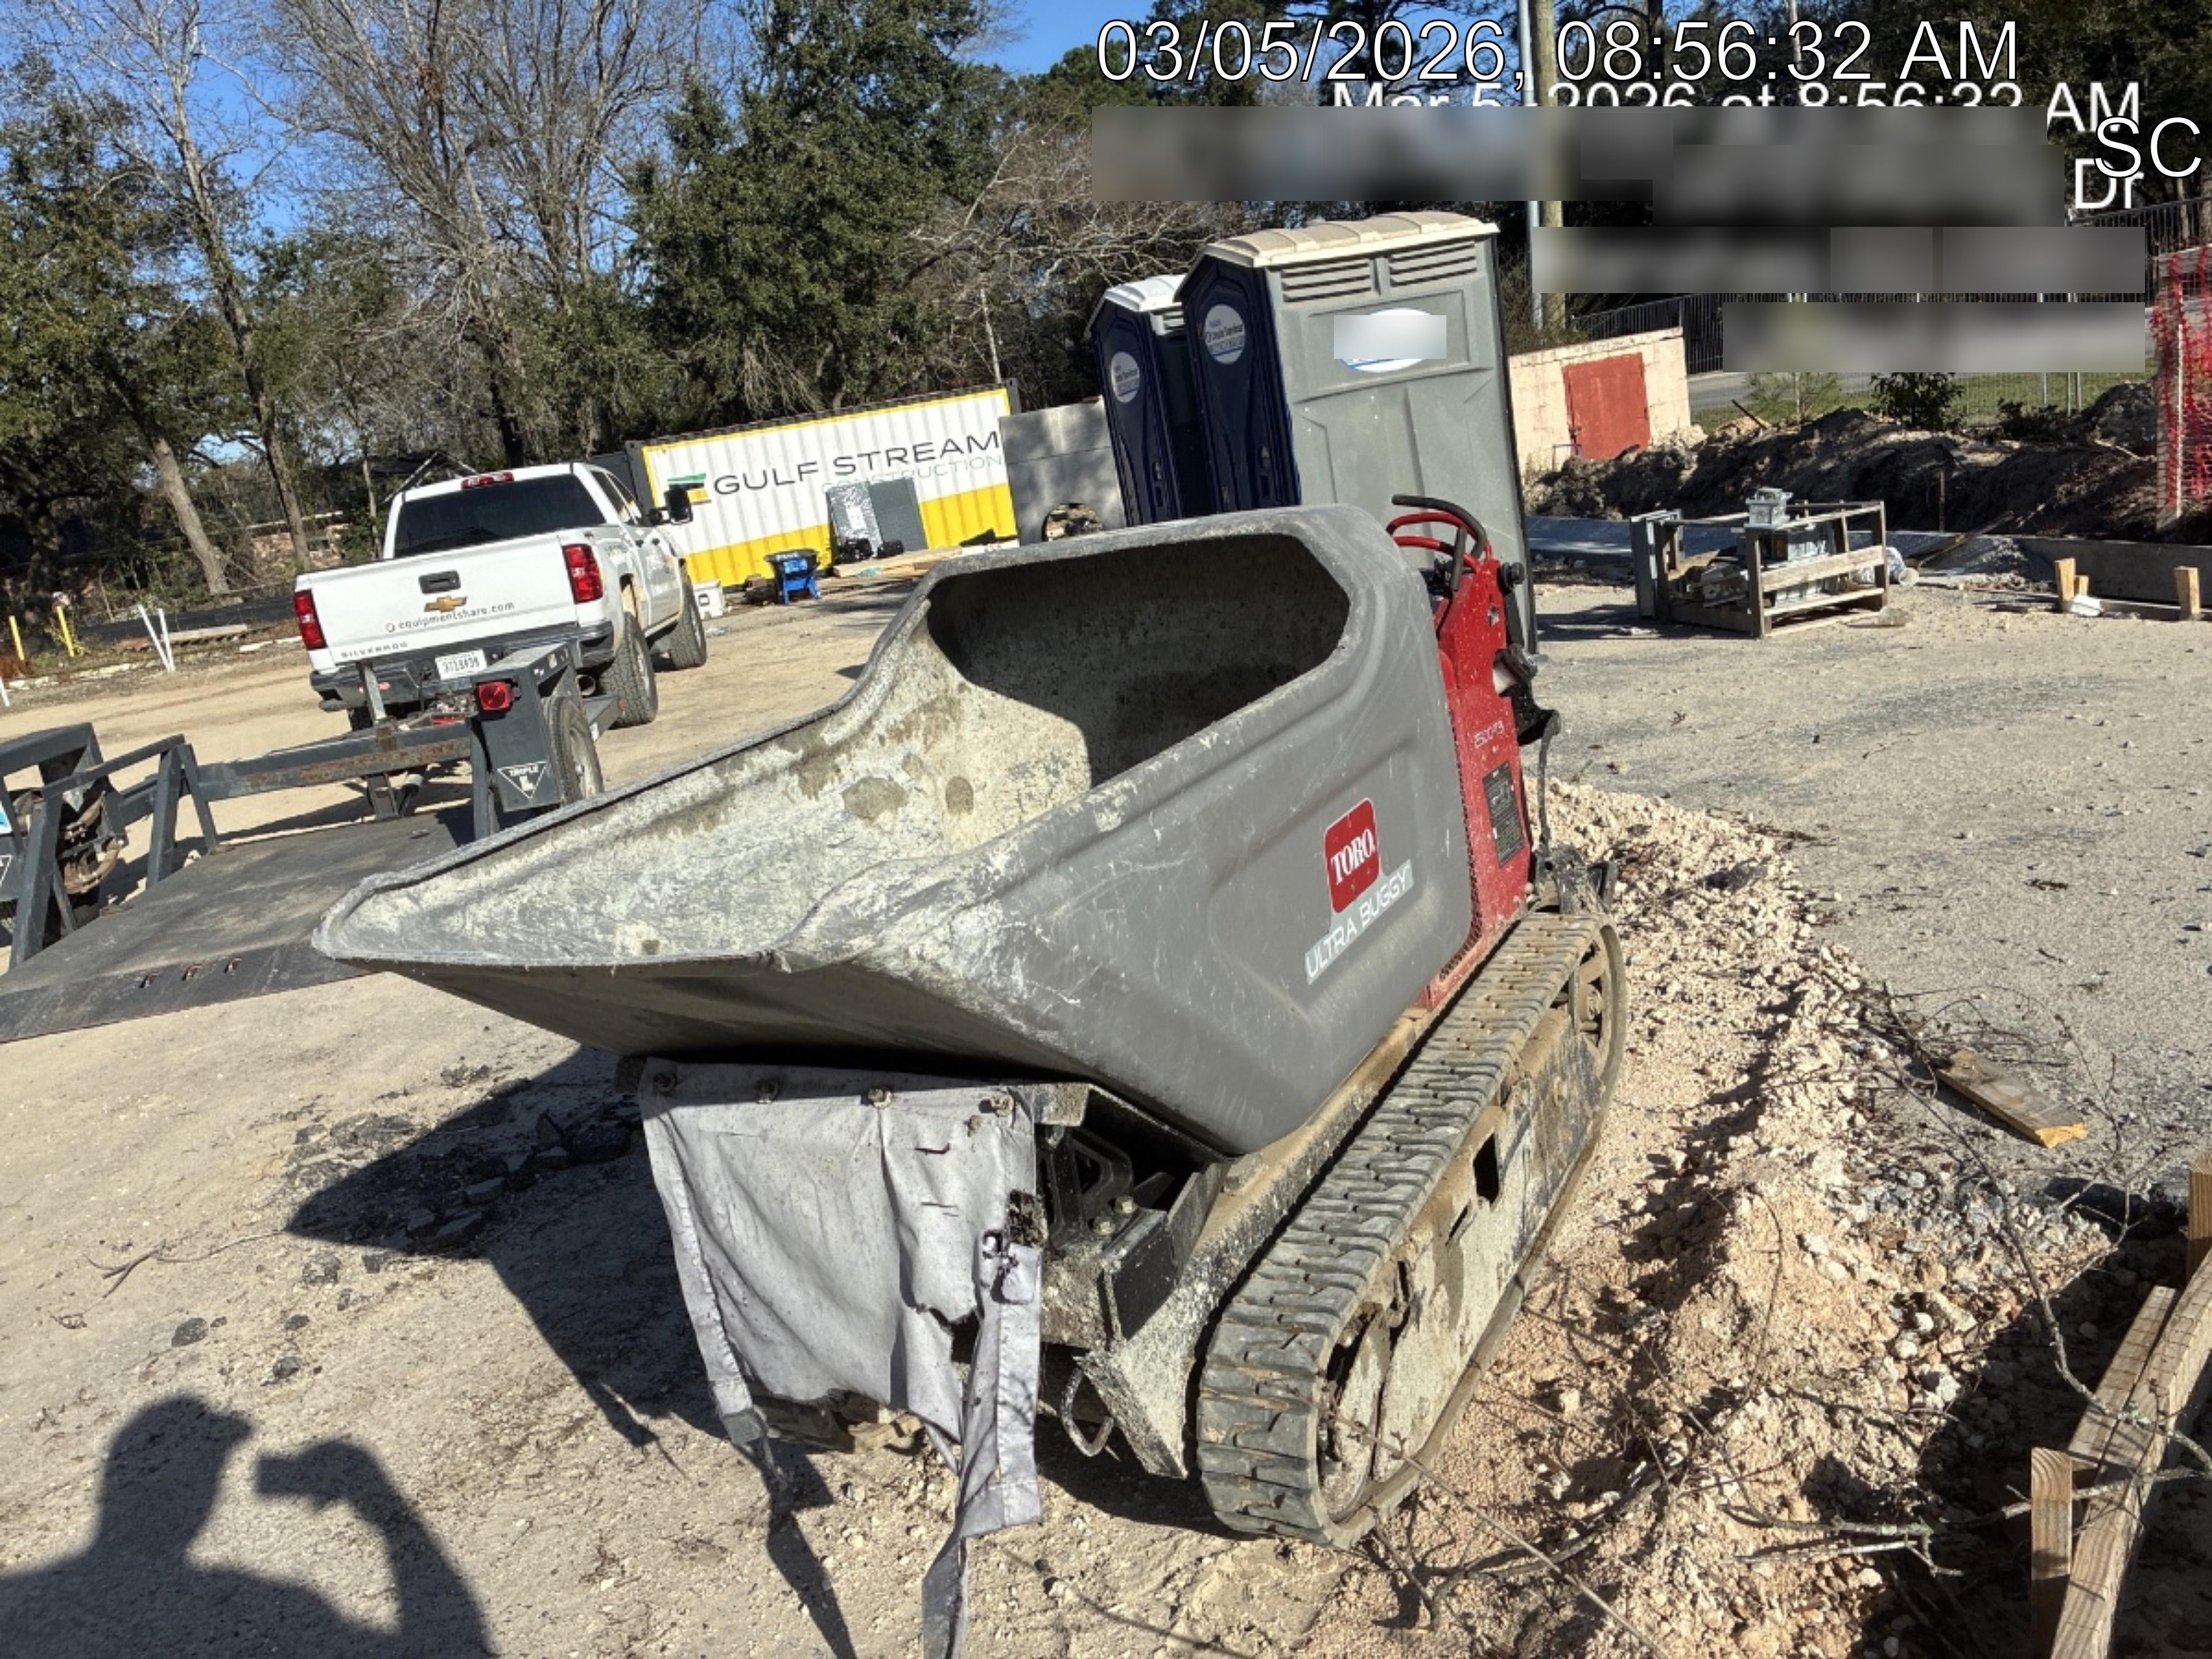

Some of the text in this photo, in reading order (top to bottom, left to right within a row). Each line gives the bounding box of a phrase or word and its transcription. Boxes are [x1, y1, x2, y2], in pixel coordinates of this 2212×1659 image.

[713, 430, 1000, 495] GULF STREAM
[399, 602, 516, 629] equipmentshare.com
[1330, 828, 1375, 885] TORO
[1306, 863, 1410, 978] ULTRA BUGGY
